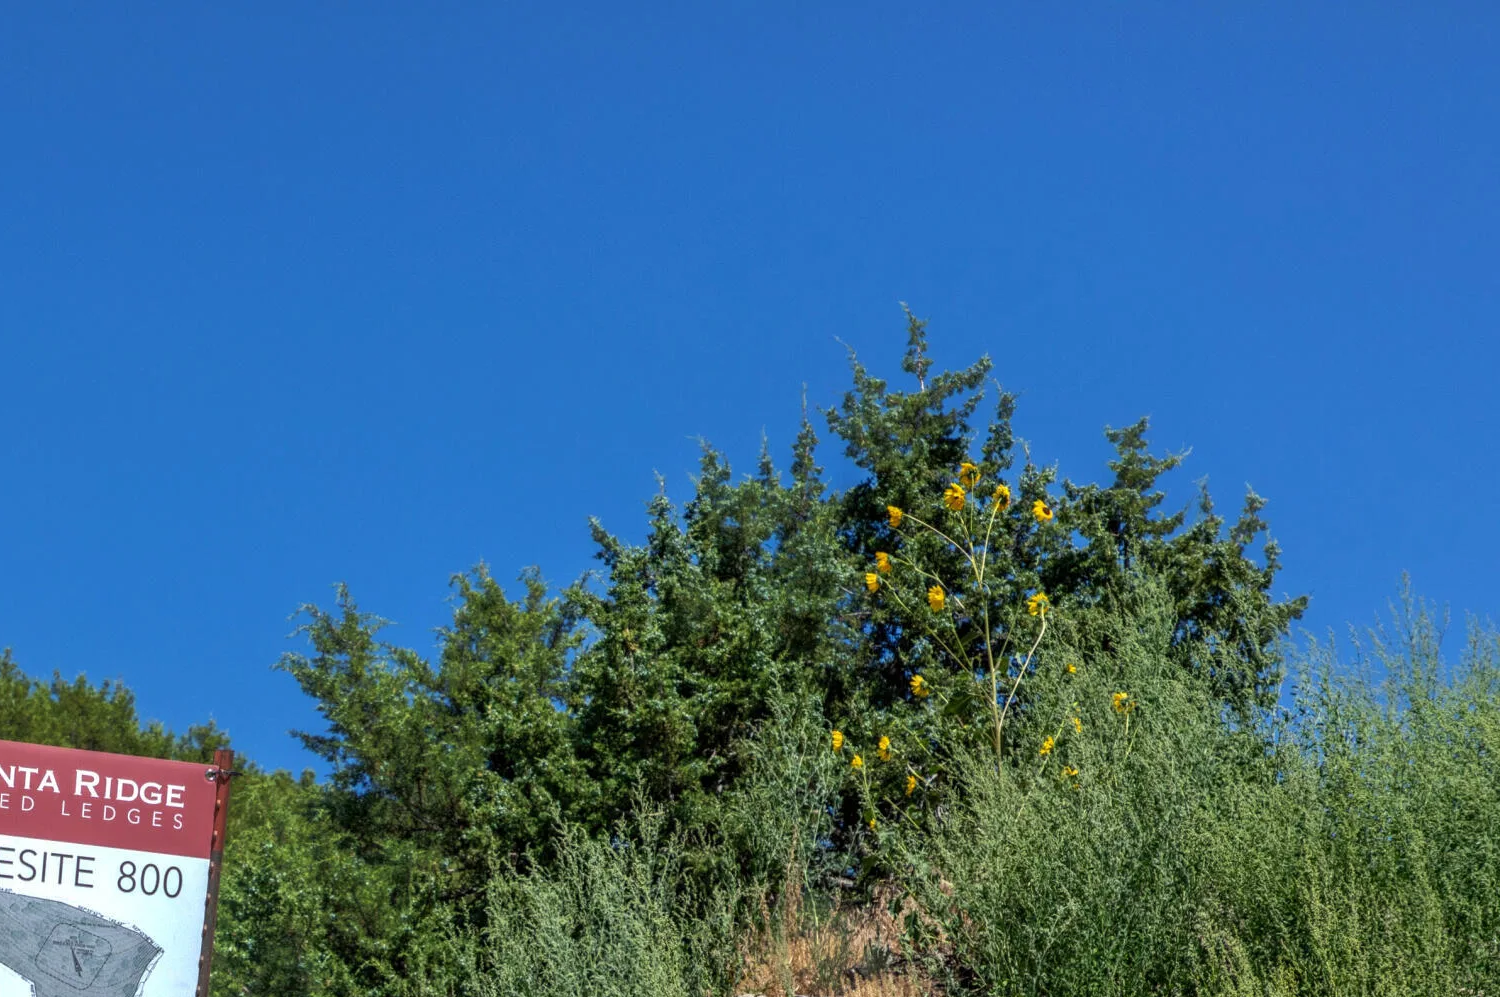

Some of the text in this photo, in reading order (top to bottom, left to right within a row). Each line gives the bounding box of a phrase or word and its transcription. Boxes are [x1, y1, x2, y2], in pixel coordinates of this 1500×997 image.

[74, 769, 186, 808] RIDGE
[61, 800, 183, 830] LEDGES
[117, 861, 183, 899] 800
